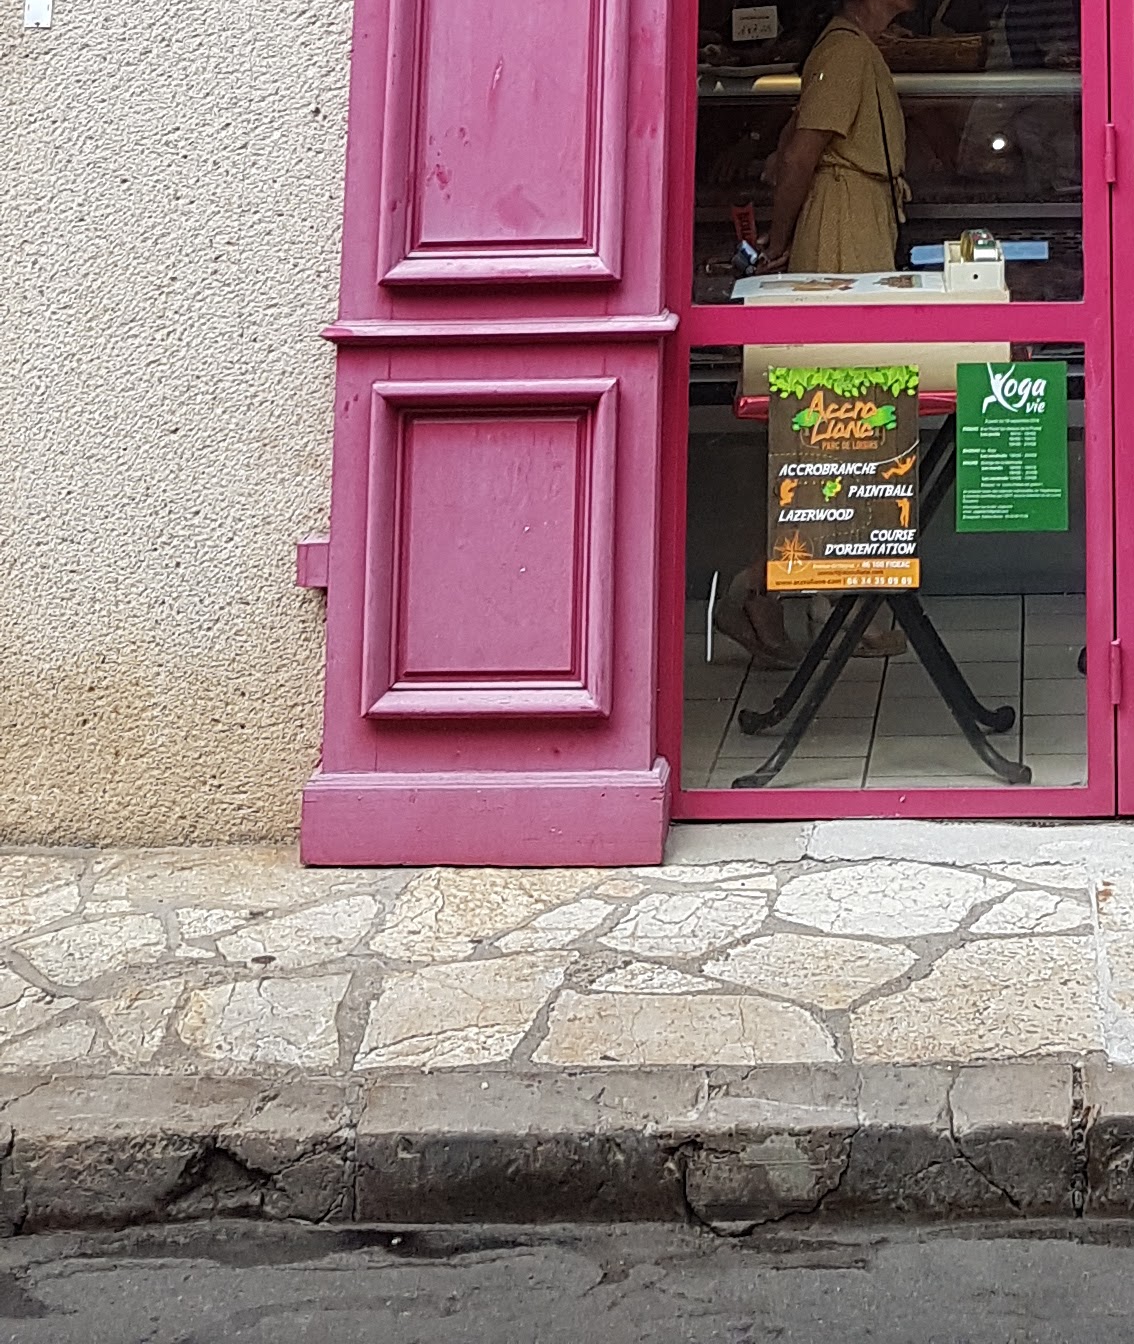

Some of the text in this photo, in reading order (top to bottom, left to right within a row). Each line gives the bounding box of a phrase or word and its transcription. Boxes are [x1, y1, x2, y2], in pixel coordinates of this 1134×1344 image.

[1026, 397, 1046, 414] vie
[779, 463, 878, 477] ACCROBRANCHE
[848, 484, 914, 498] PAINTBALL
[778, 508, 855, 522] LAZERWOOD
[870, 529, 916, 541] COURSE
[824, 543, 917, 556] D'ORIENTATION
